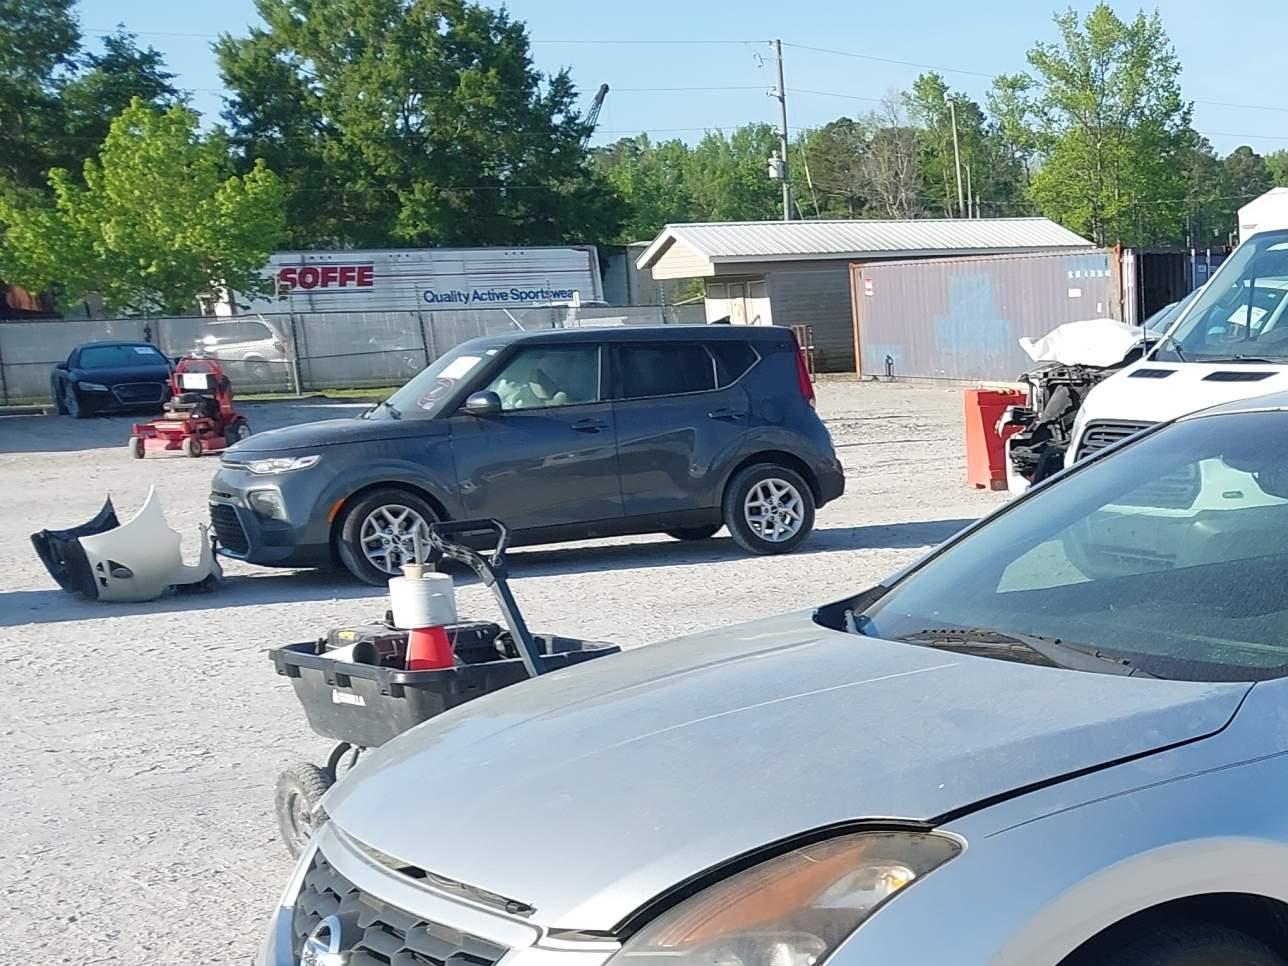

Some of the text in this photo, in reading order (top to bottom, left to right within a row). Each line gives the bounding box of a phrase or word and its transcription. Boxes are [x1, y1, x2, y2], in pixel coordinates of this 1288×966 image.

[280, 266, 374, 290] SOFFE
[423, 290, 470, 304] Quality
[471, 289, 508, 301] Active
